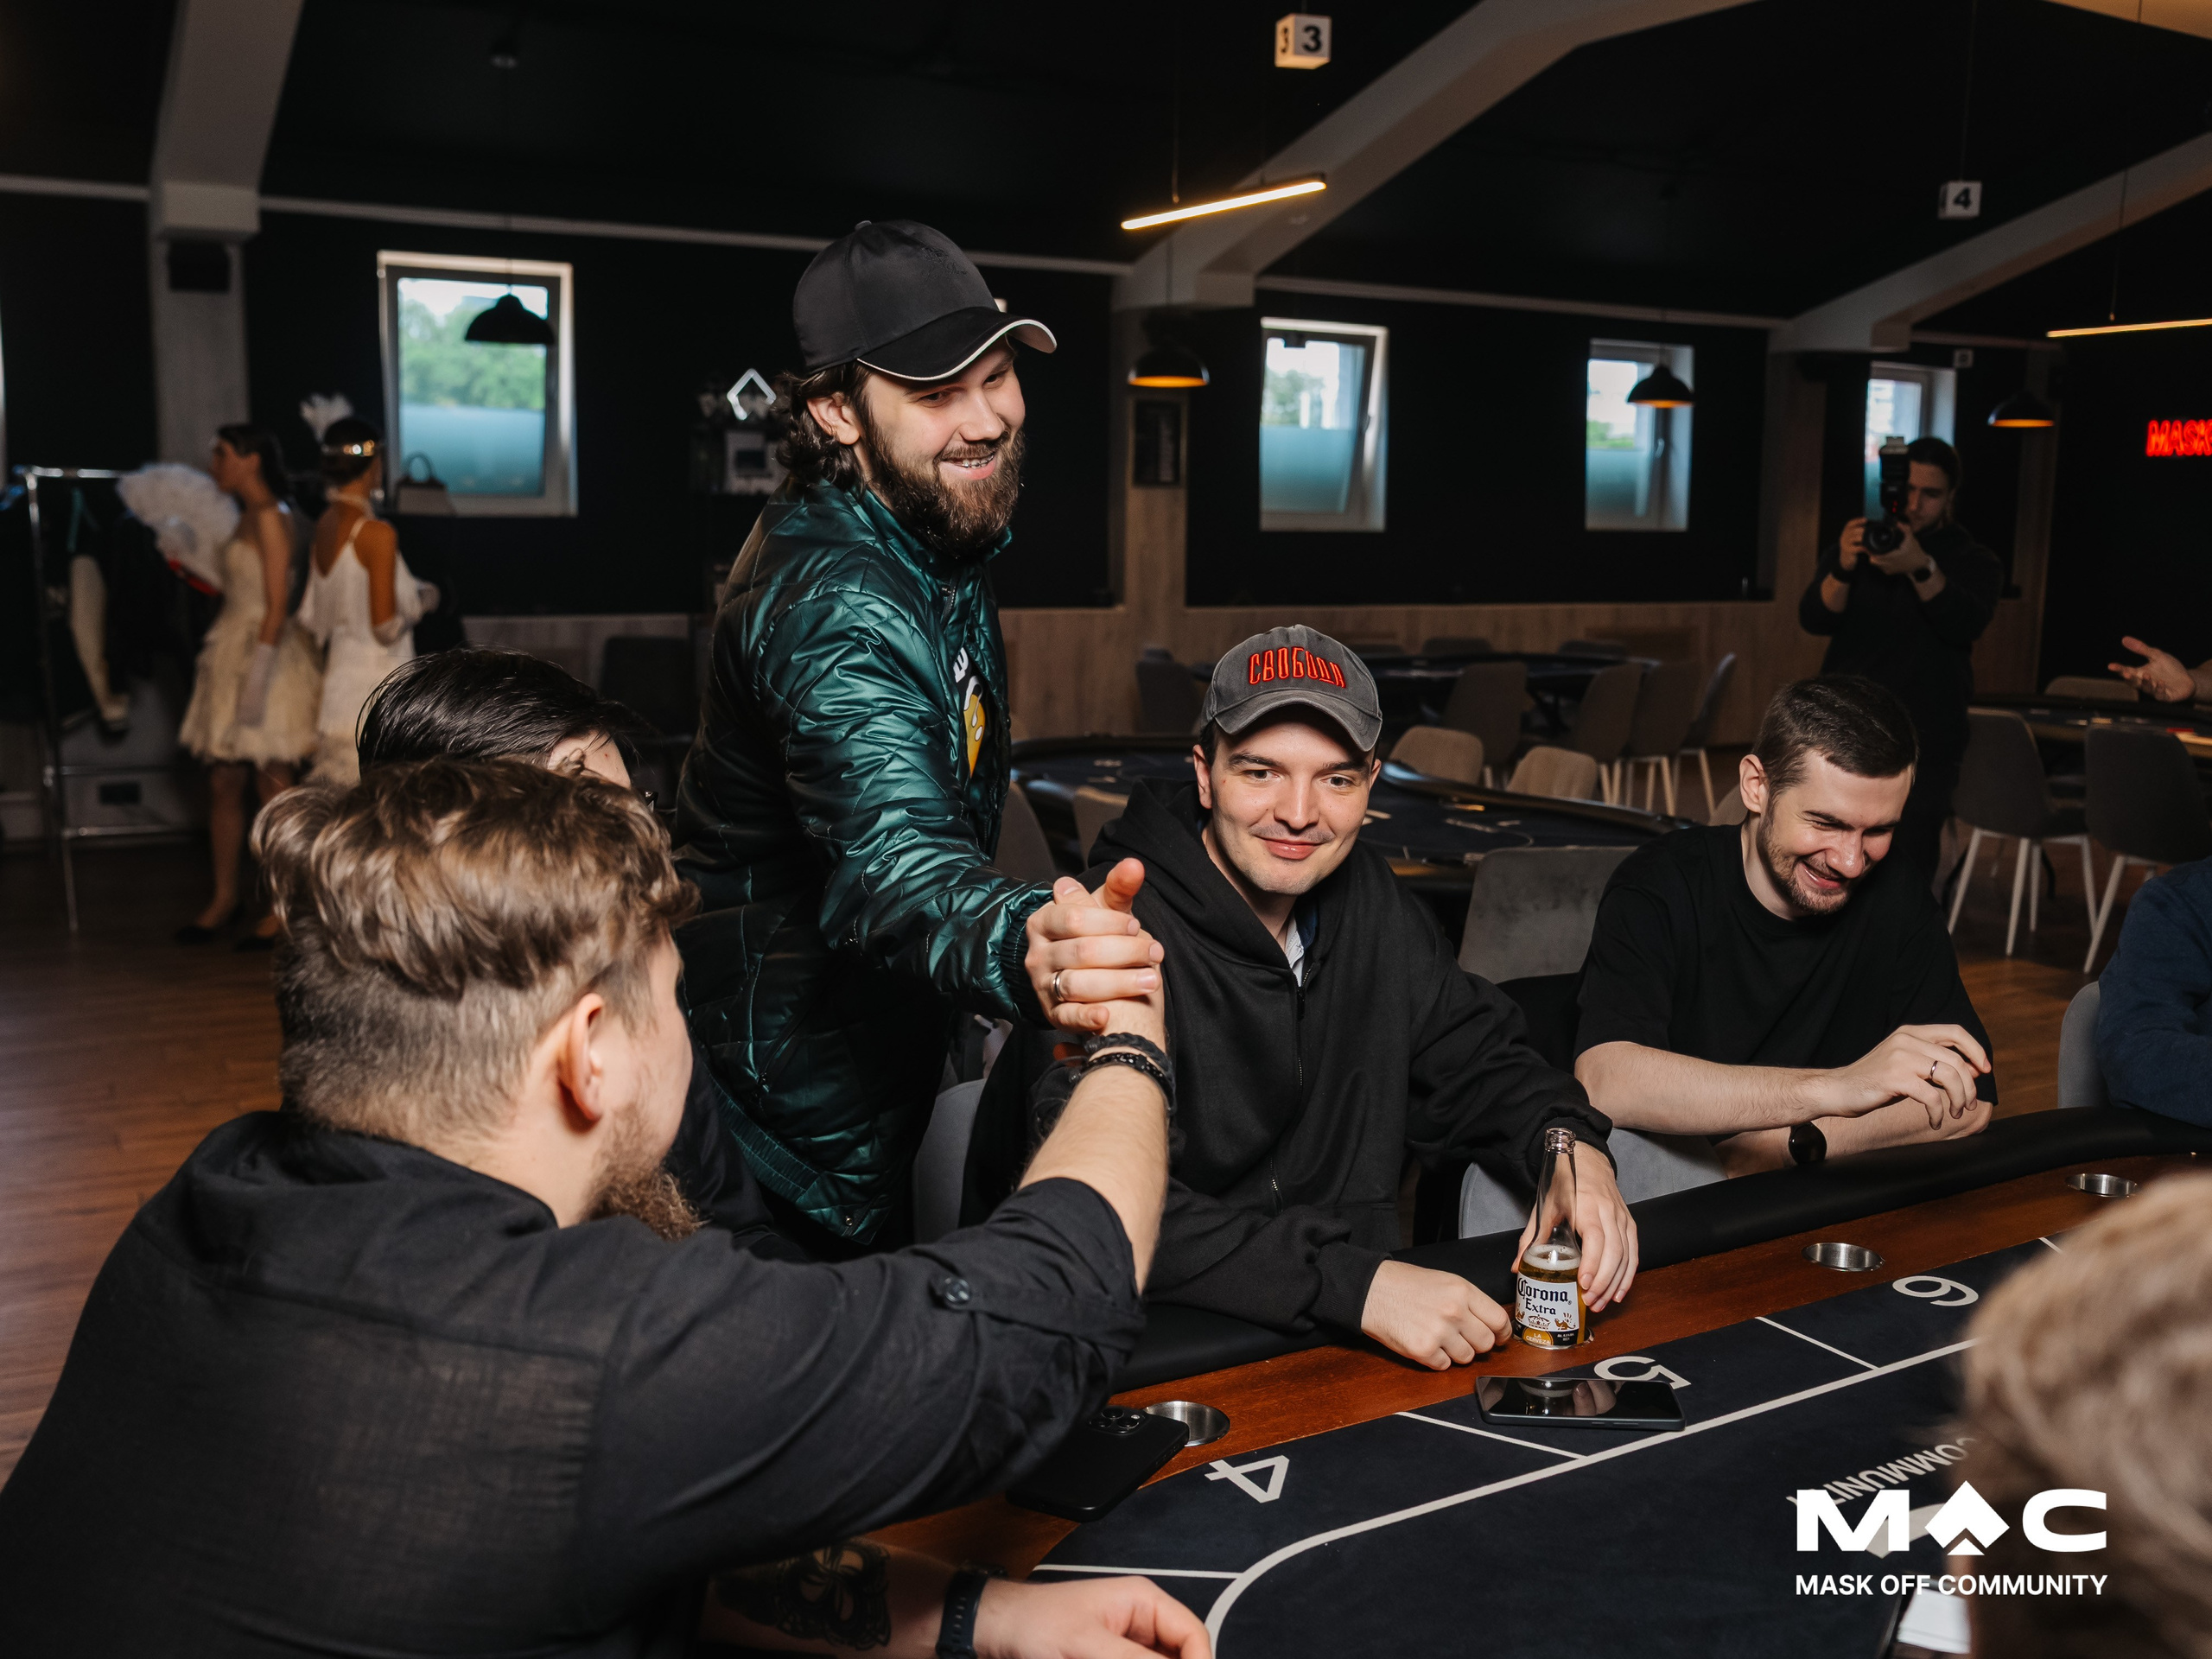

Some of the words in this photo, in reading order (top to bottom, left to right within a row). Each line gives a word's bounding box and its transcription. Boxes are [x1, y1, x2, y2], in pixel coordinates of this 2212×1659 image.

[1302, 25, 1323, 53] 3
[1953, 187, 1972, 210] 4
[1248, 645, 1346, 688] СВОБОДА
[1518, 1278, 1568, 1302] Corona
[1891, 1275, 1979, 1307] 6
[1525, 1298, 1556, 1315] Extra
[1593, 1356, 1692, 1389] 5
[1205, 1455, 1289, 1503] 4
